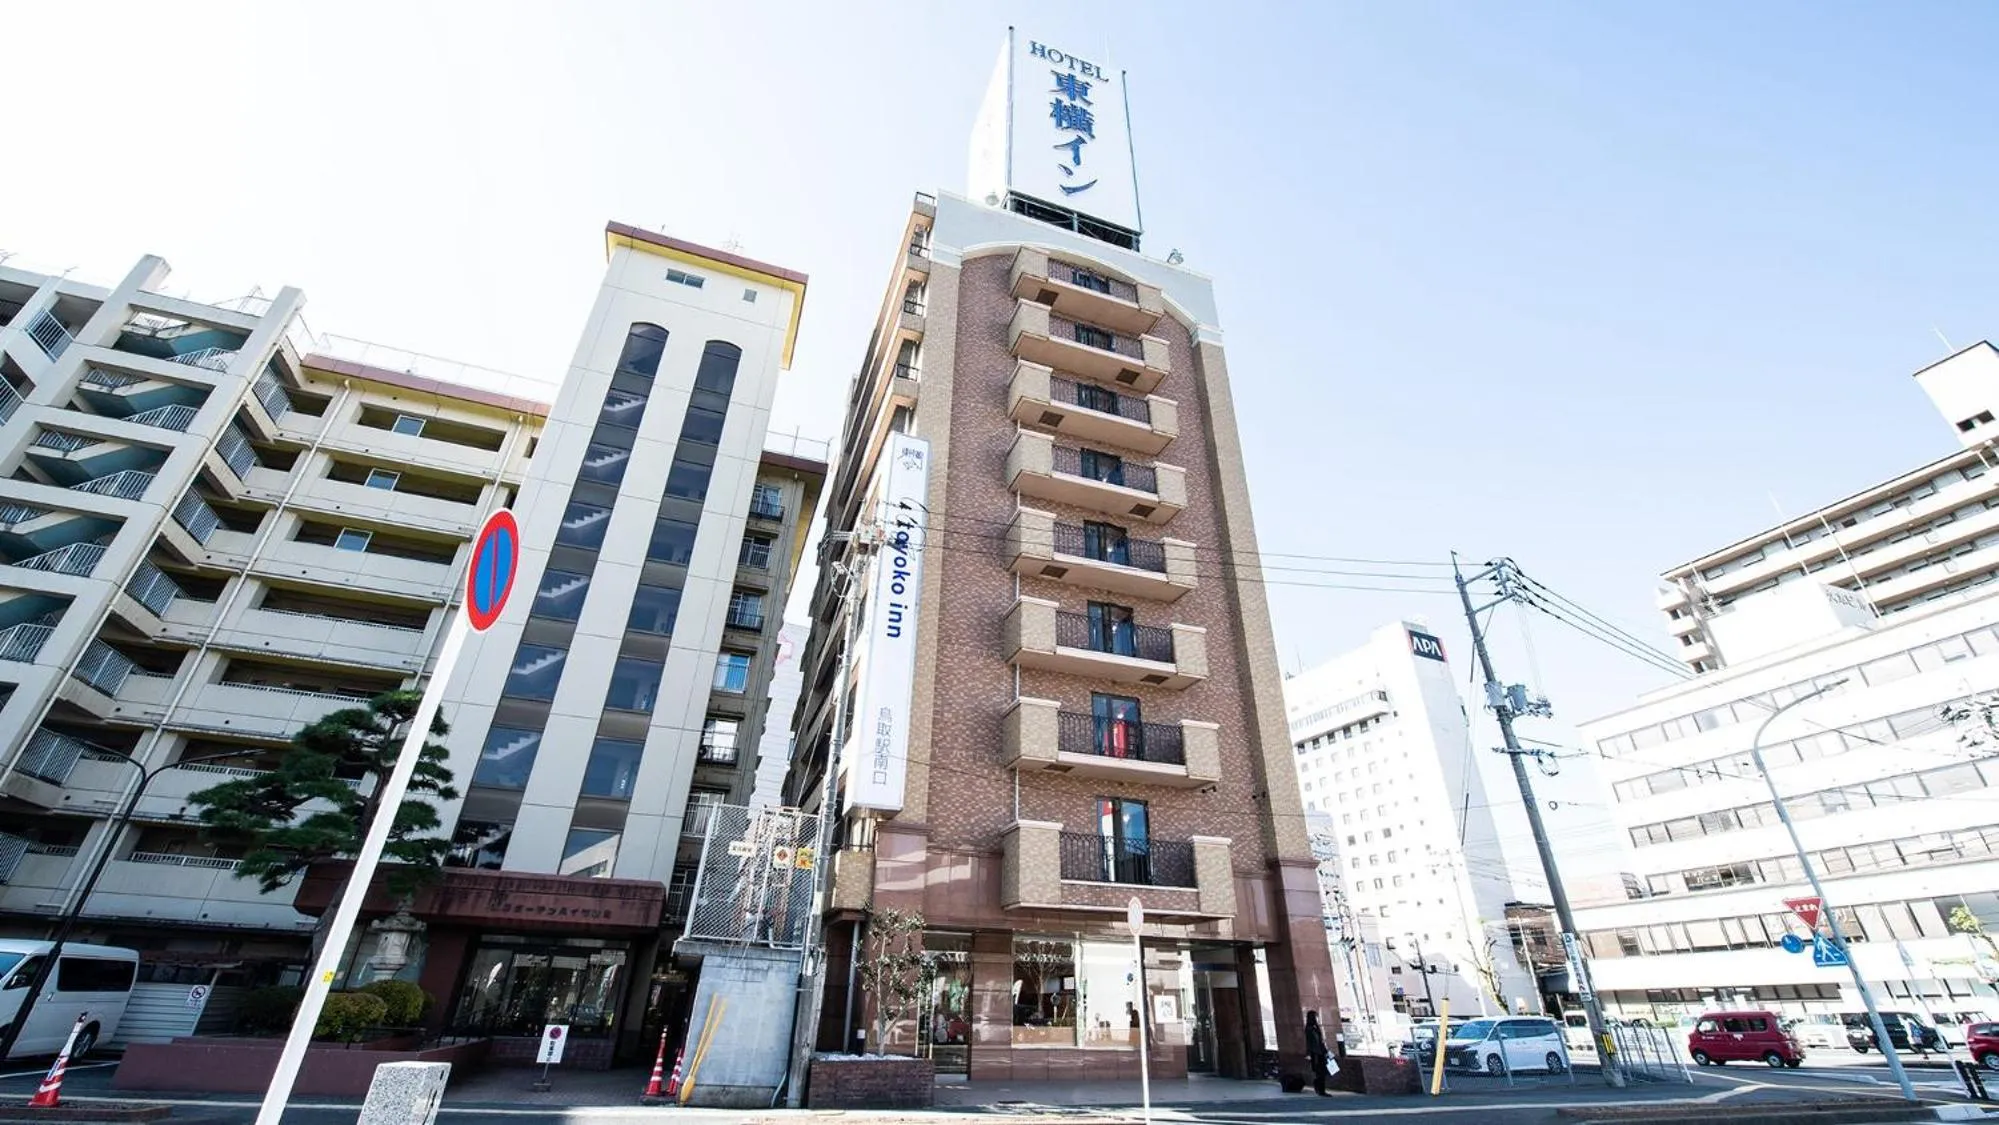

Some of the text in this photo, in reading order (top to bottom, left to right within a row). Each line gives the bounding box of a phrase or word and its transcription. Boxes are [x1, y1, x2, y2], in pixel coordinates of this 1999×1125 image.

[1029, 40, 1109, 83] HOTEL
[1049, 69, 1098, 196] 東横イン
[886, 602, 909, 638] inn
[1412, 636, 1443, 657] APA
[872, 706, 893, 786] 鳥取駅南口
